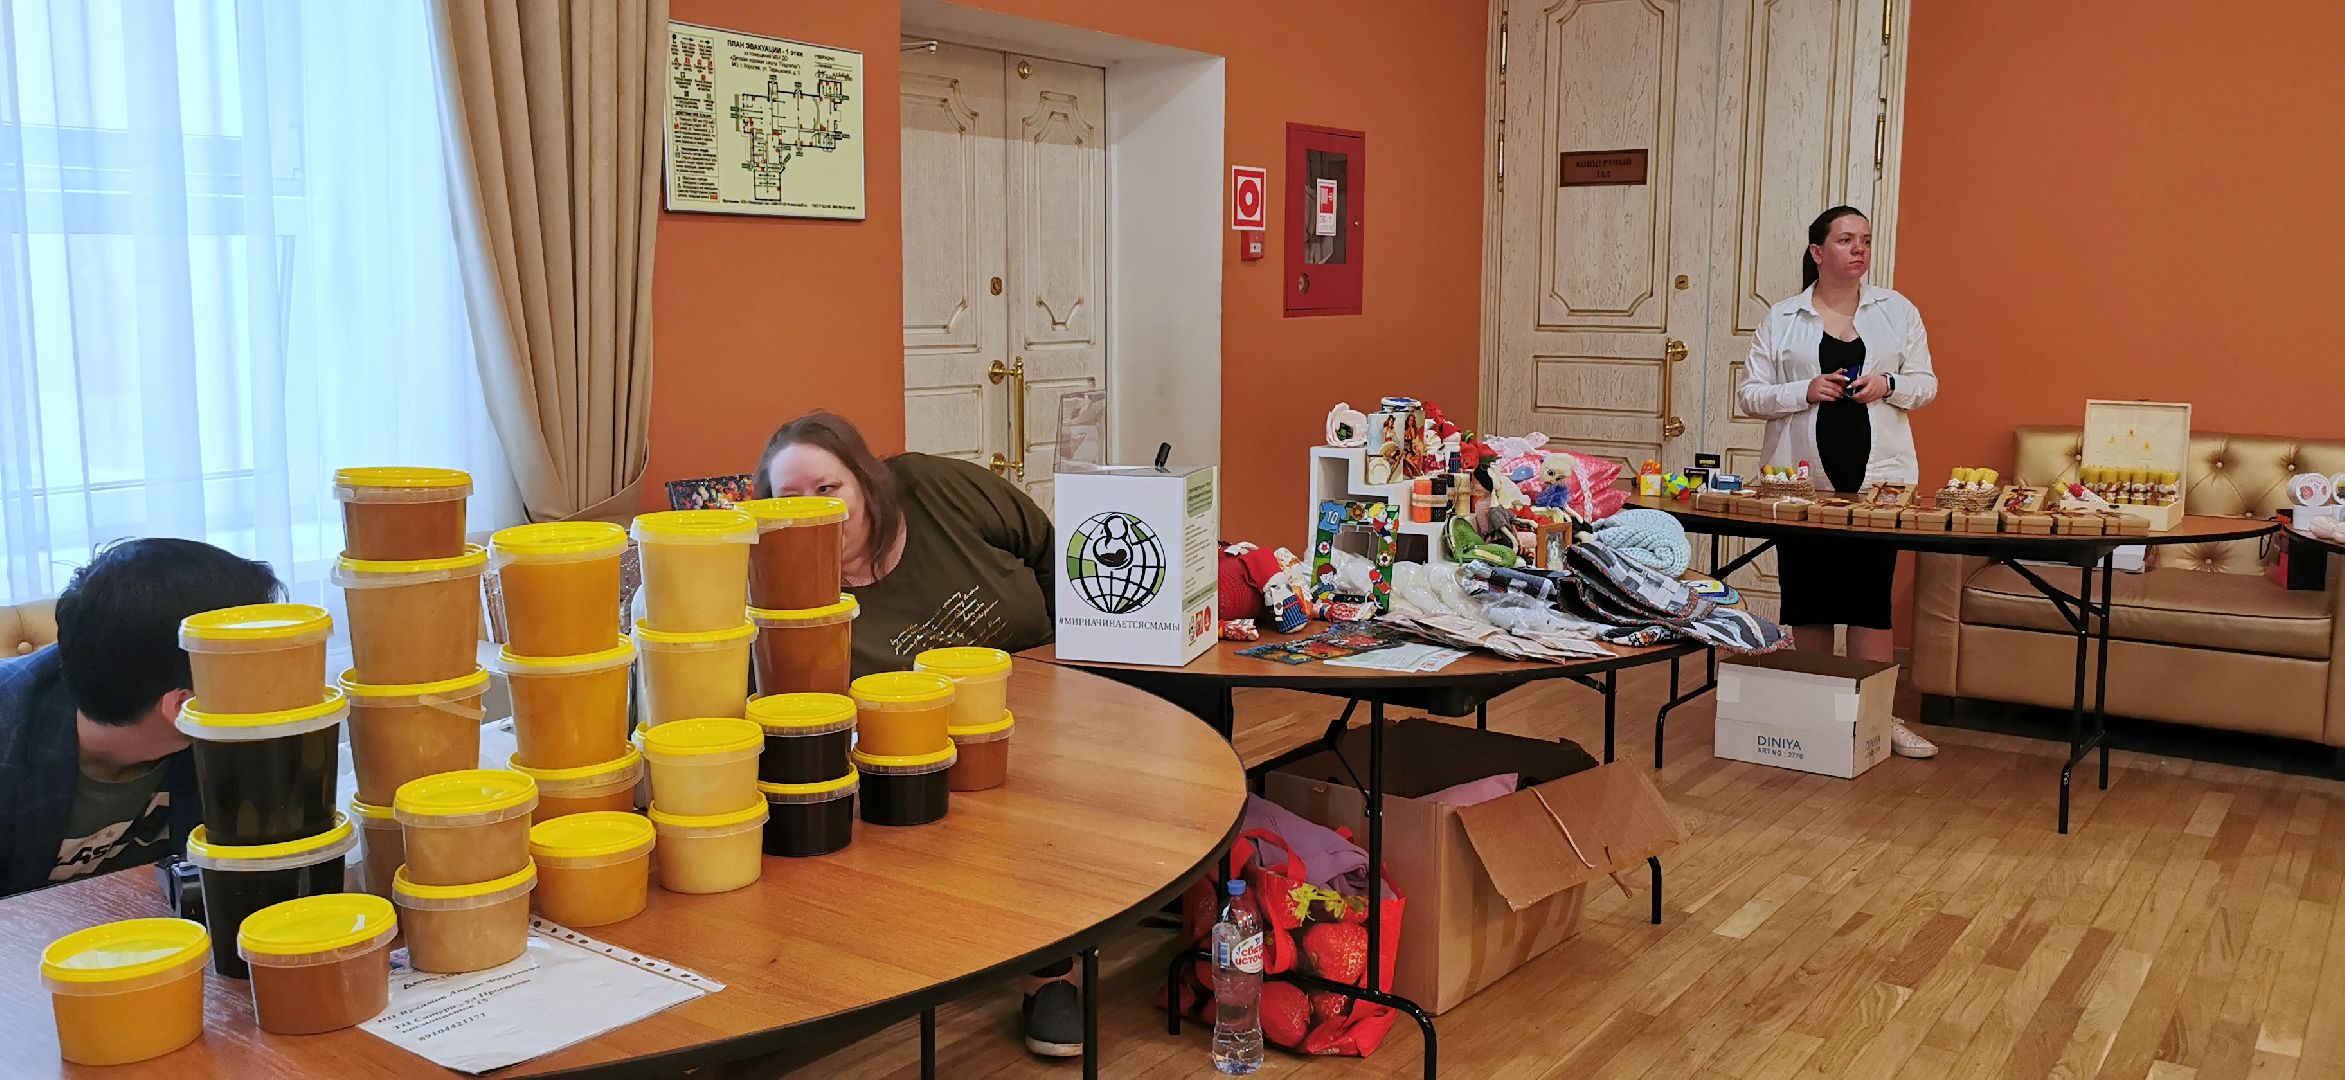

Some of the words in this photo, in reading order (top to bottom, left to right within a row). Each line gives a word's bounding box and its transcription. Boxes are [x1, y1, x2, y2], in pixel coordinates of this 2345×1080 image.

[727, 40, 744, 48] ПЛАН
[746, 43, 781, 54] ЭВАКУАЦИИ
[1327, 510, 1338, 525] 10
[1059, 617, 1180, 632] #МИРНАЧИНАЕТСЯСМАМЫ
[1757, 735, 1802, 751] DINIYA
